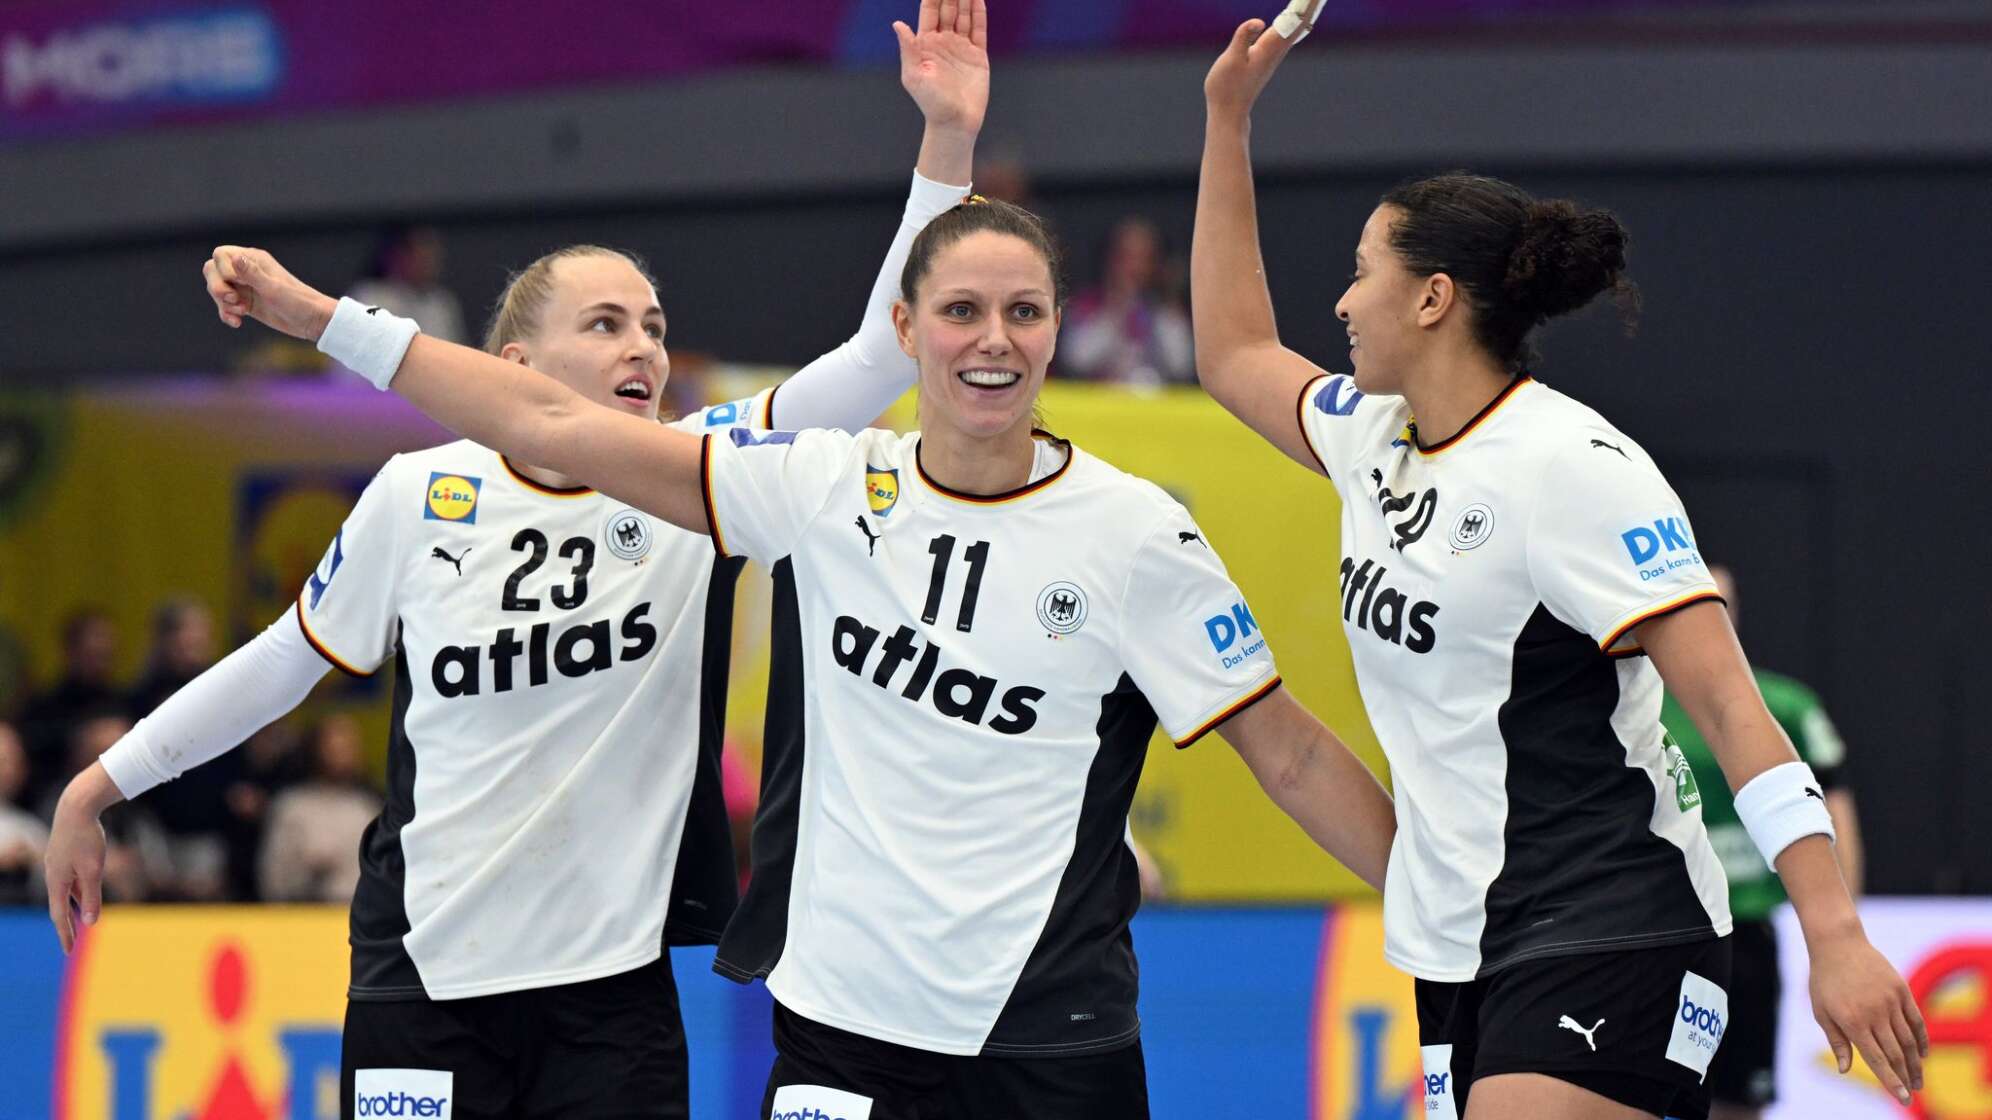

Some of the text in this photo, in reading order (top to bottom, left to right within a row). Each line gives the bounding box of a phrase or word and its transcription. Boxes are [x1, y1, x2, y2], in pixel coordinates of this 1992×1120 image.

[502, 528, 596, 611] 23
[921, 533, 990, 633] 11
[1640, 566, 1665, 581] Das
[431, 601, 657, 698] atlas
[832, 615, 1047, 734] atlas
[1222, 654, 1243, 669] Das
[358, 1091, 448, 1117] brother
